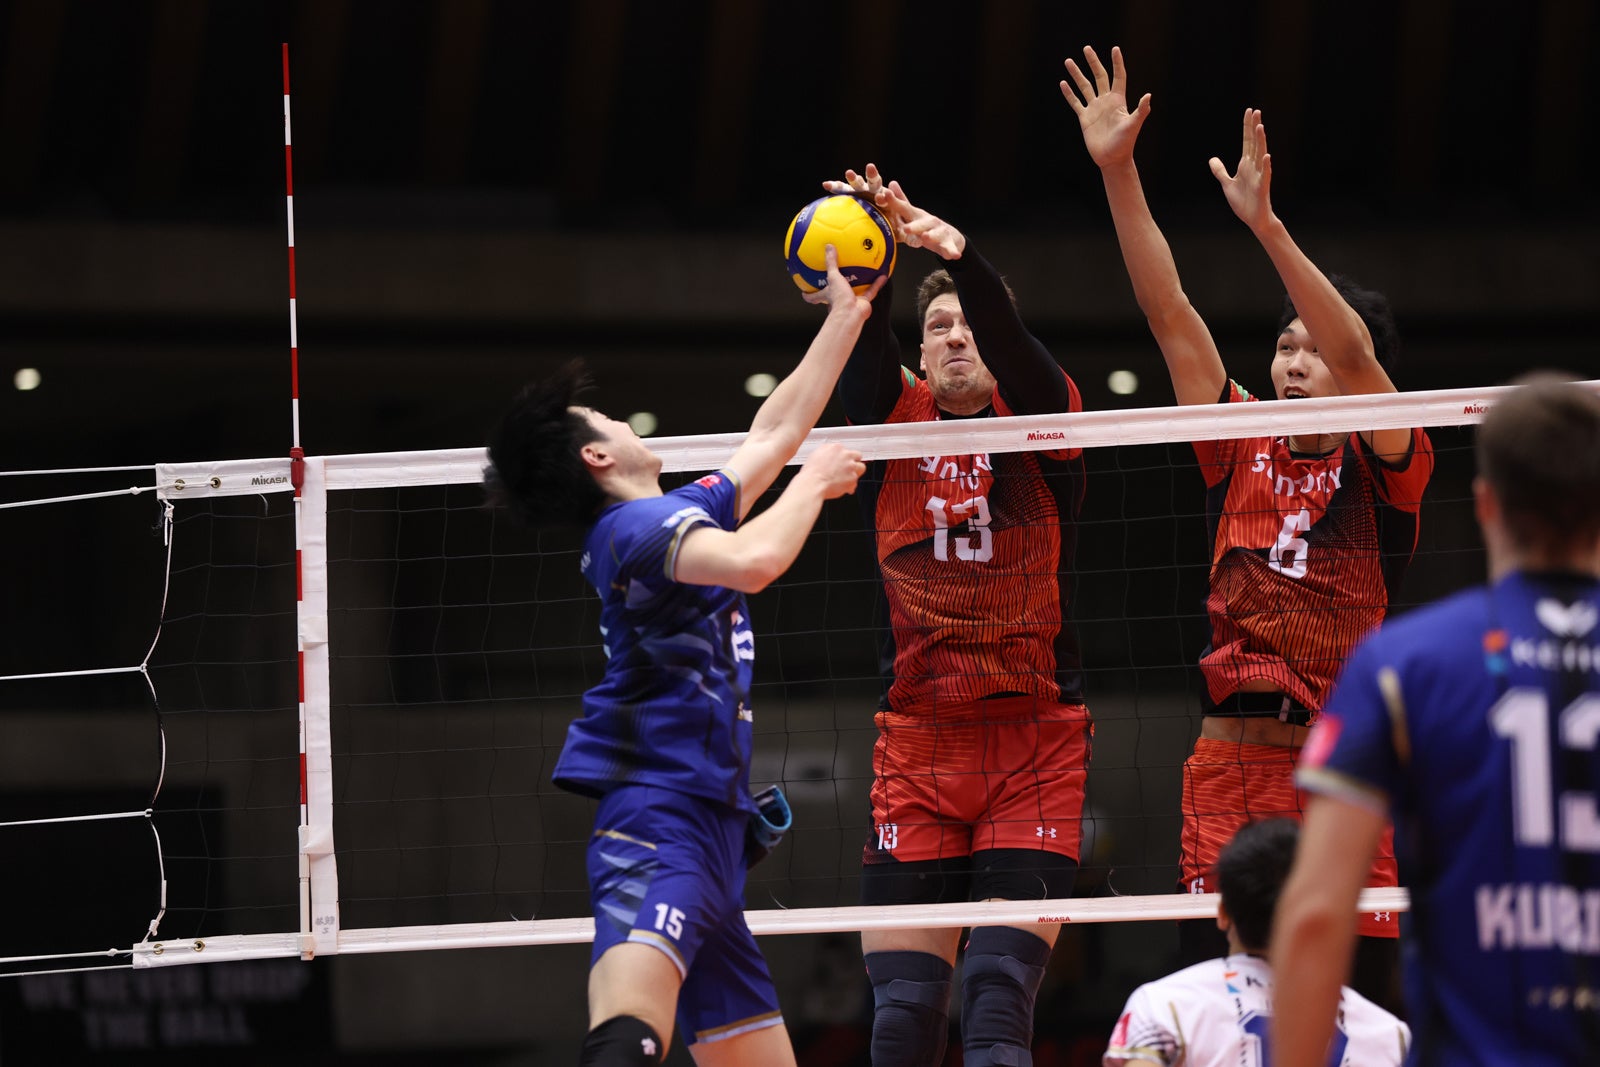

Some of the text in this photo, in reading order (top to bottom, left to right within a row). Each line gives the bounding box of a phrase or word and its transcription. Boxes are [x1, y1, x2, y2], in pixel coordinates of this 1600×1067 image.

[925, 495, 994, 563] 13
[1268, 506, 1311, 579] 6
[878, 823, 898, 850] 13
[655, 902, 686, 940] 15
